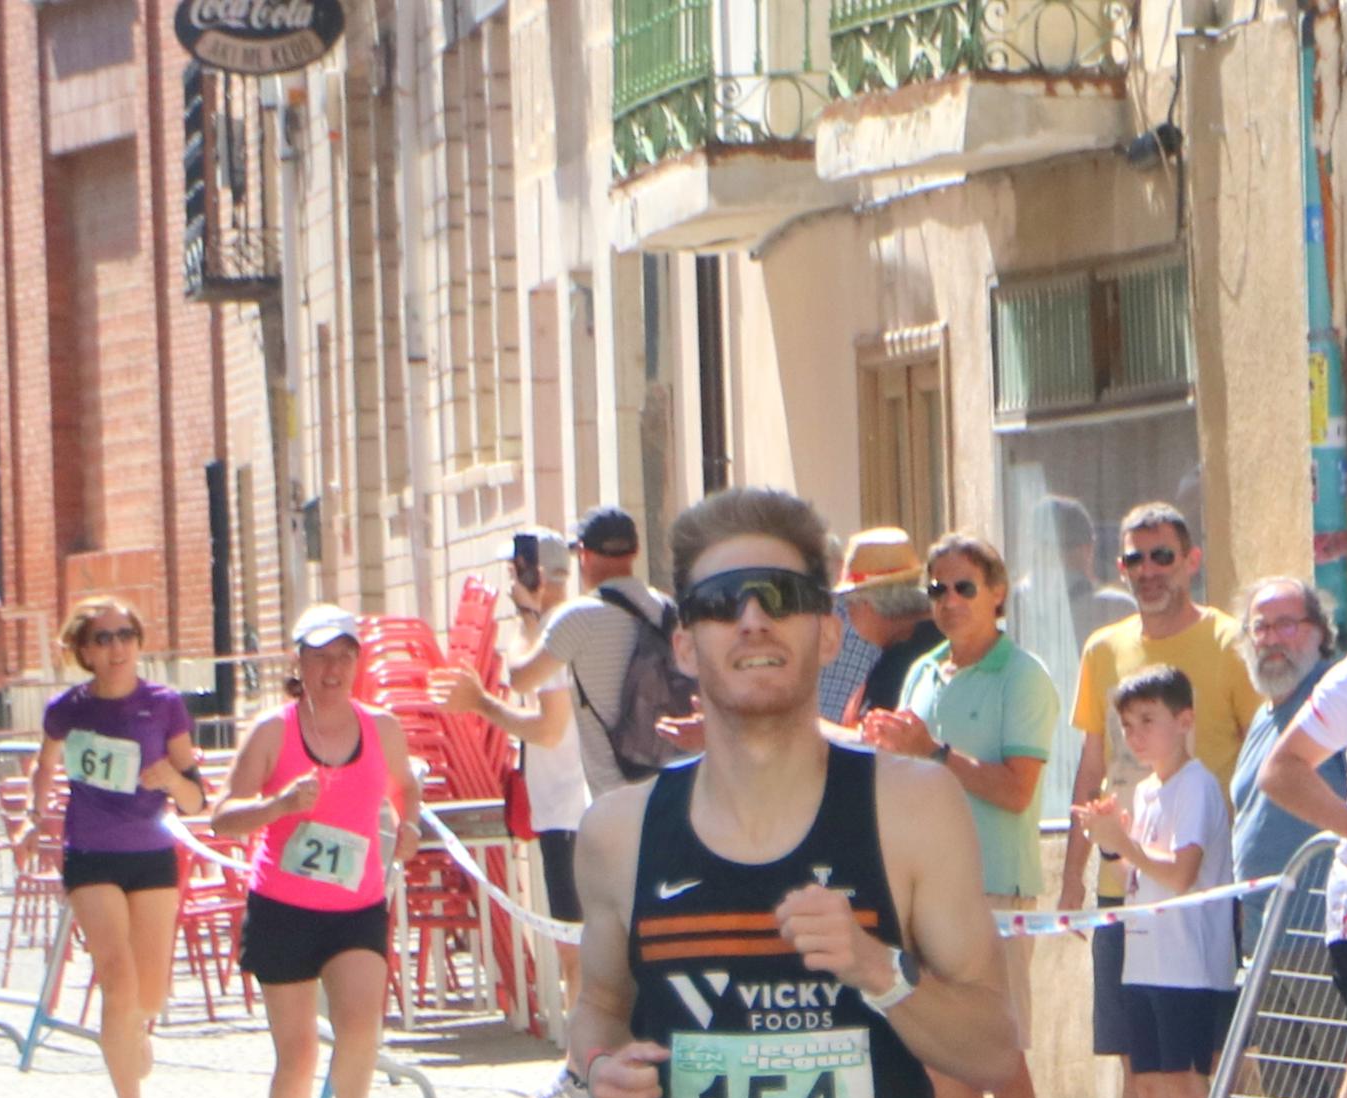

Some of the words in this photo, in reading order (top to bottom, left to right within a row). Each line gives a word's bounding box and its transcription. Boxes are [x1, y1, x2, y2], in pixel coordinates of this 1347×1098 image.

[80, 748, 114, 780] 61
[301, 838, 341, 874] 21
[737, 982, 844, 1009] VICKY
[751, 1011, 834, 1032] FOODS
